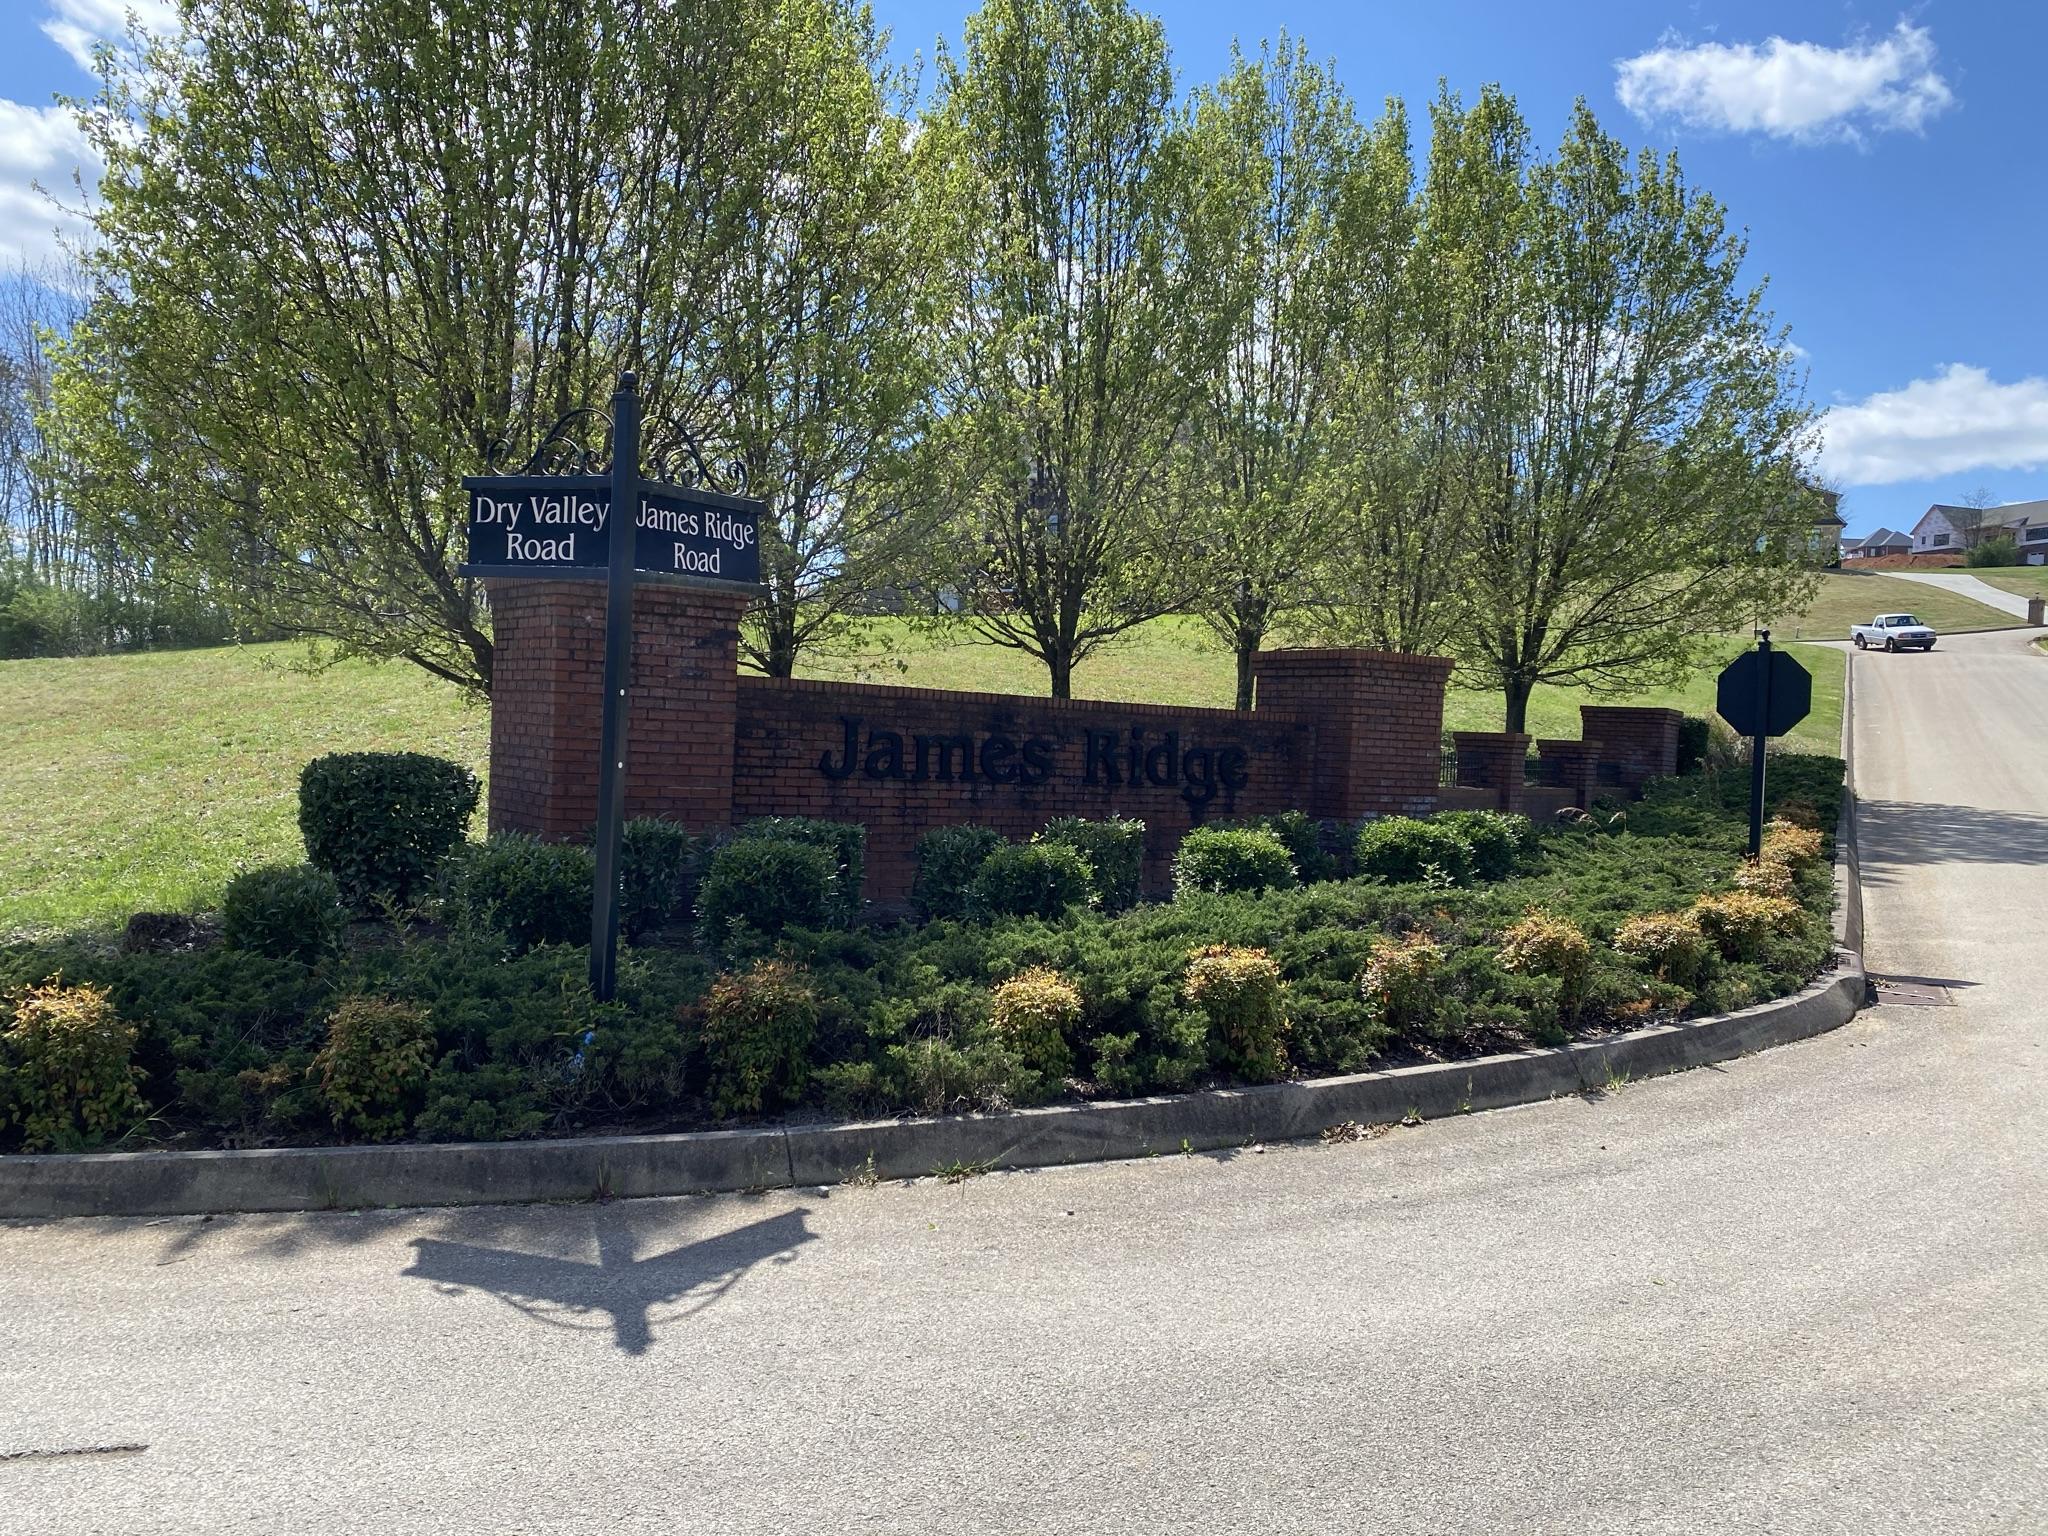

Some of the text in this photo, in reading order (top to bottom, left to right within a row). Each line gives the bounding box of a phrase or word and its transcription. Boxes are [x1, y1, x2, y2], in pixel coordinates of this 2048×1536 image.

[475, 496, 610, 532] Dry Valley
[636, 500, 755, 550] James Ridge
[505, 533, 575, 561] Road
[673, 542, 721, 574] Road
[819, 715, 1249, 802] James Ridge
